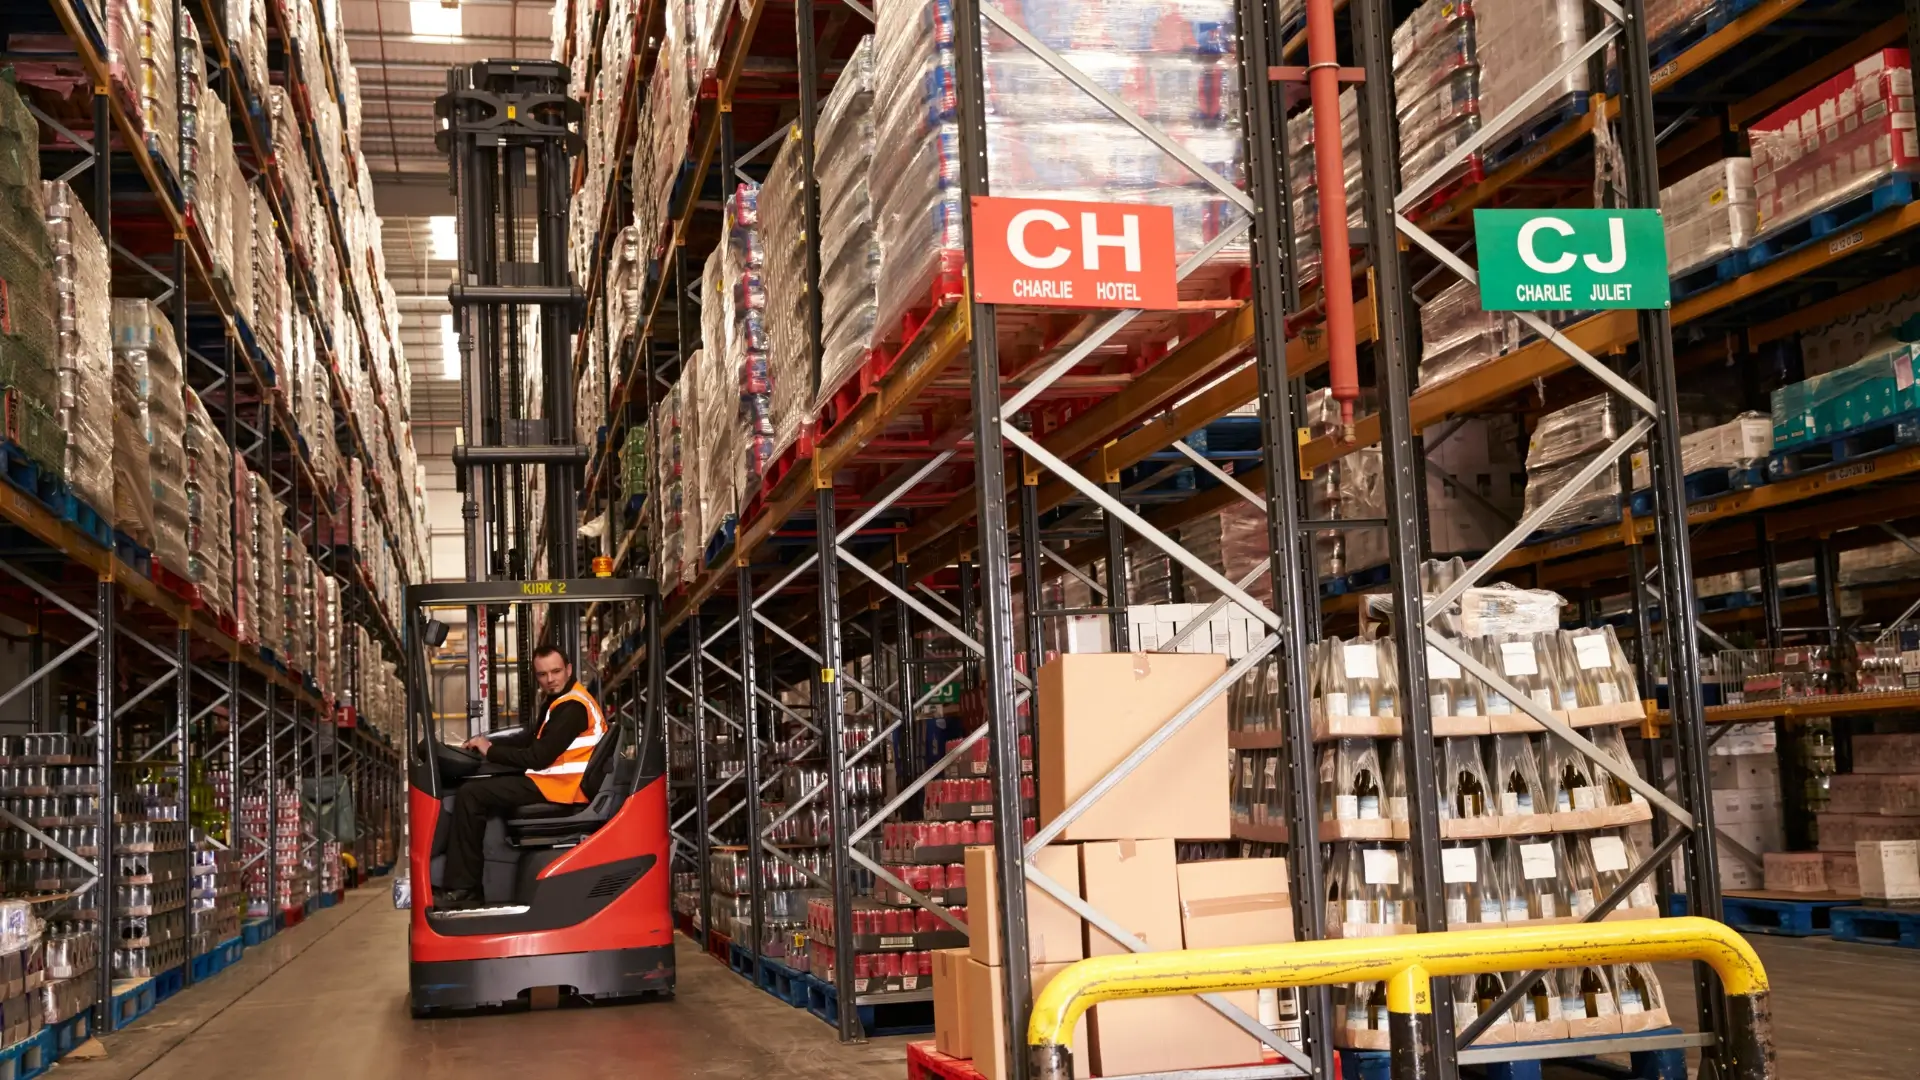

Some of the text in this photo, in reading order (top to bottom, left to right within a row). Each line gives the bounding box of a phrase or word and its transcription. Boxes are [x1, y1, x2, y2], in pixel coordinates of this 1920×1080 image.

[1006, 208, 1141, 272] CH
[1517, 216, 1627, 274] CJ
[1013, 279, 1141, 301] CHARLIE HOTEL
[1516, 284, 1632, 301] CHARLIE JULIET
[523, 582, 567, 595] KIRK 2
[478, 645, 489, 698] MAST
